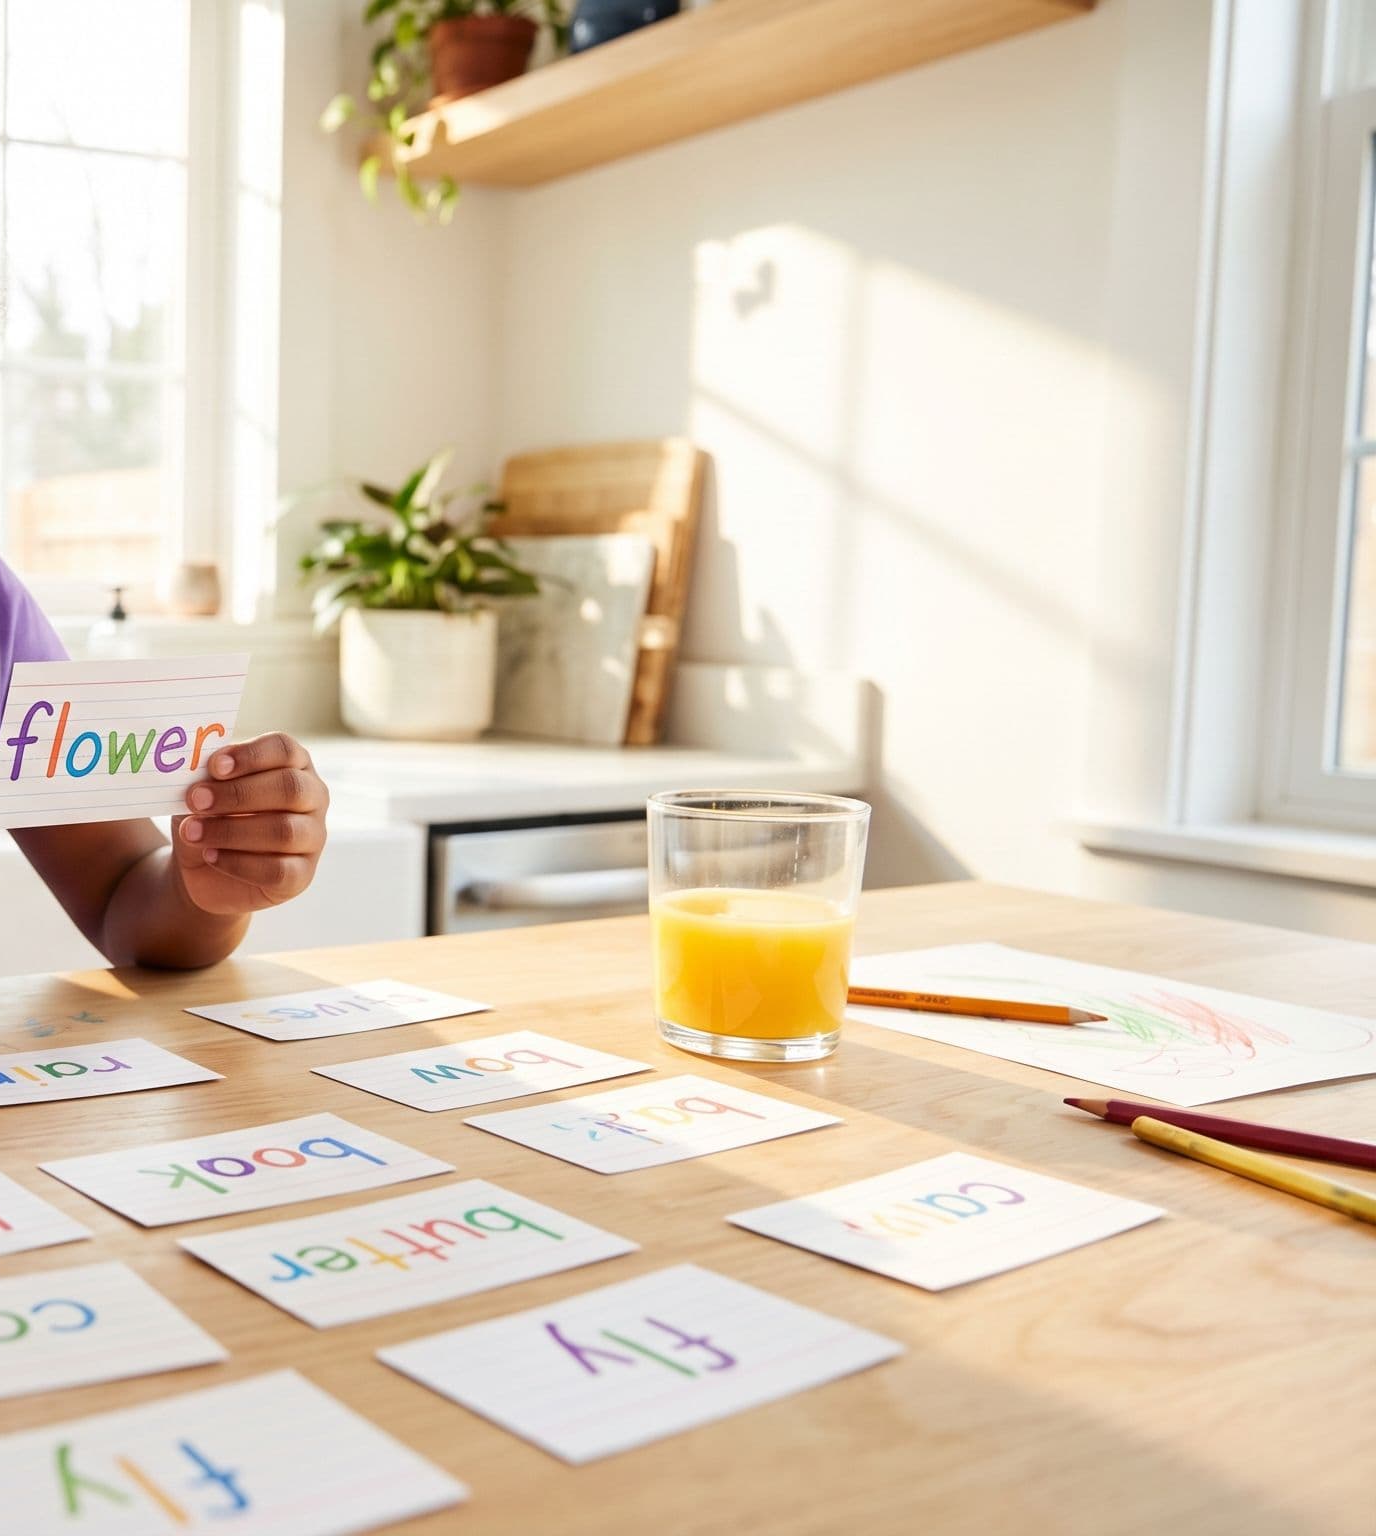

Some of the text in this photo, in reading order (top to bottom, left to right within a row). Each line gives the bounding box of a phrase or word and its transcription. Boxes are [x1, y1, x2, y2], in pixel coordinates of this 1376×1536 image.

[7, 700, 226, 781] flower
[409, 1048, 585, 1085] bow
[268, 1203, 565, 1283] butter
[543, 1318, 738, 1377] fly
[54, 1441, 251, 1525] fly
